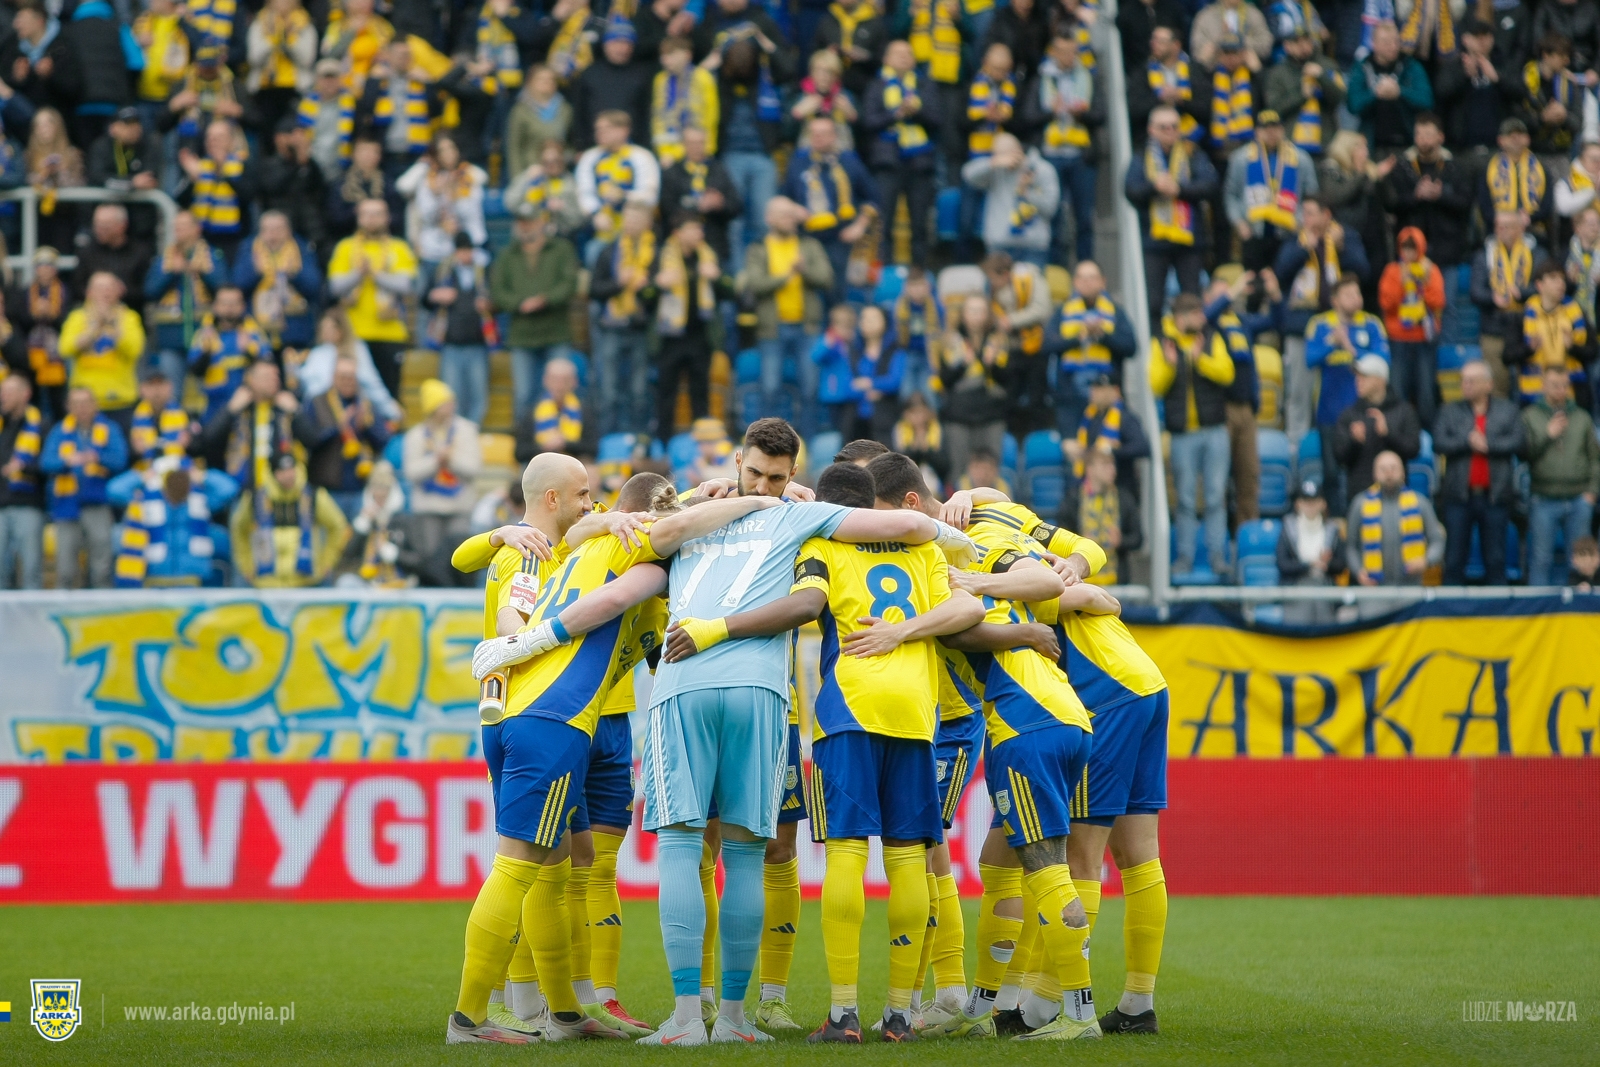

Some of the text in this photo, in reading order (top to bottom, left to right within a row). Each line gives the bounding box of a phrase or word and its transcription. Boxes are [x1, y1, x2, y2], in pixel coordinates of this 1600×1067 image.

[676, 540, 772, 612] 77
[866, 563, 918, 622] 8
[51, 601, 483, 722] TOME
[1179, 650, 1600, 757] ARKA G
